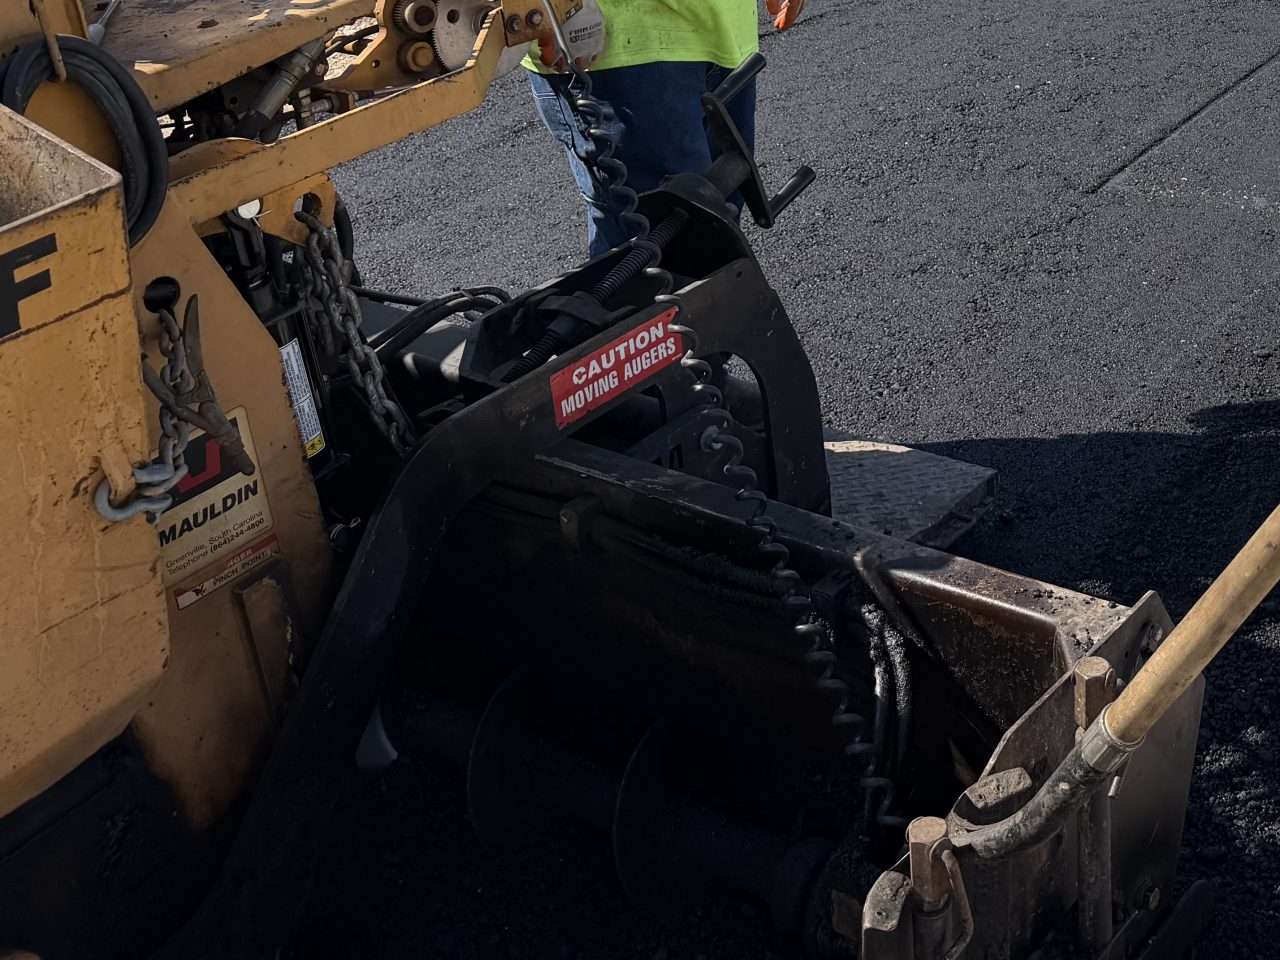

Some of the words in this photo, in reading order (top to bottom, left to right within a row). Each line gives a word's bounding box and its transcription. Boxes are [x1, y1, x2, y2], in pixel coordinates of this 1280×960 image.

[561, 370, 619, 416] MOVING
[624, 337, 676, 380] AUGERS
[572, 321, 664, 385] CAUTION
[158, 479, 258, 547] MAULDIN
[208, 527, 232, 545] South
[232, 511, 263, 531] Carolina
